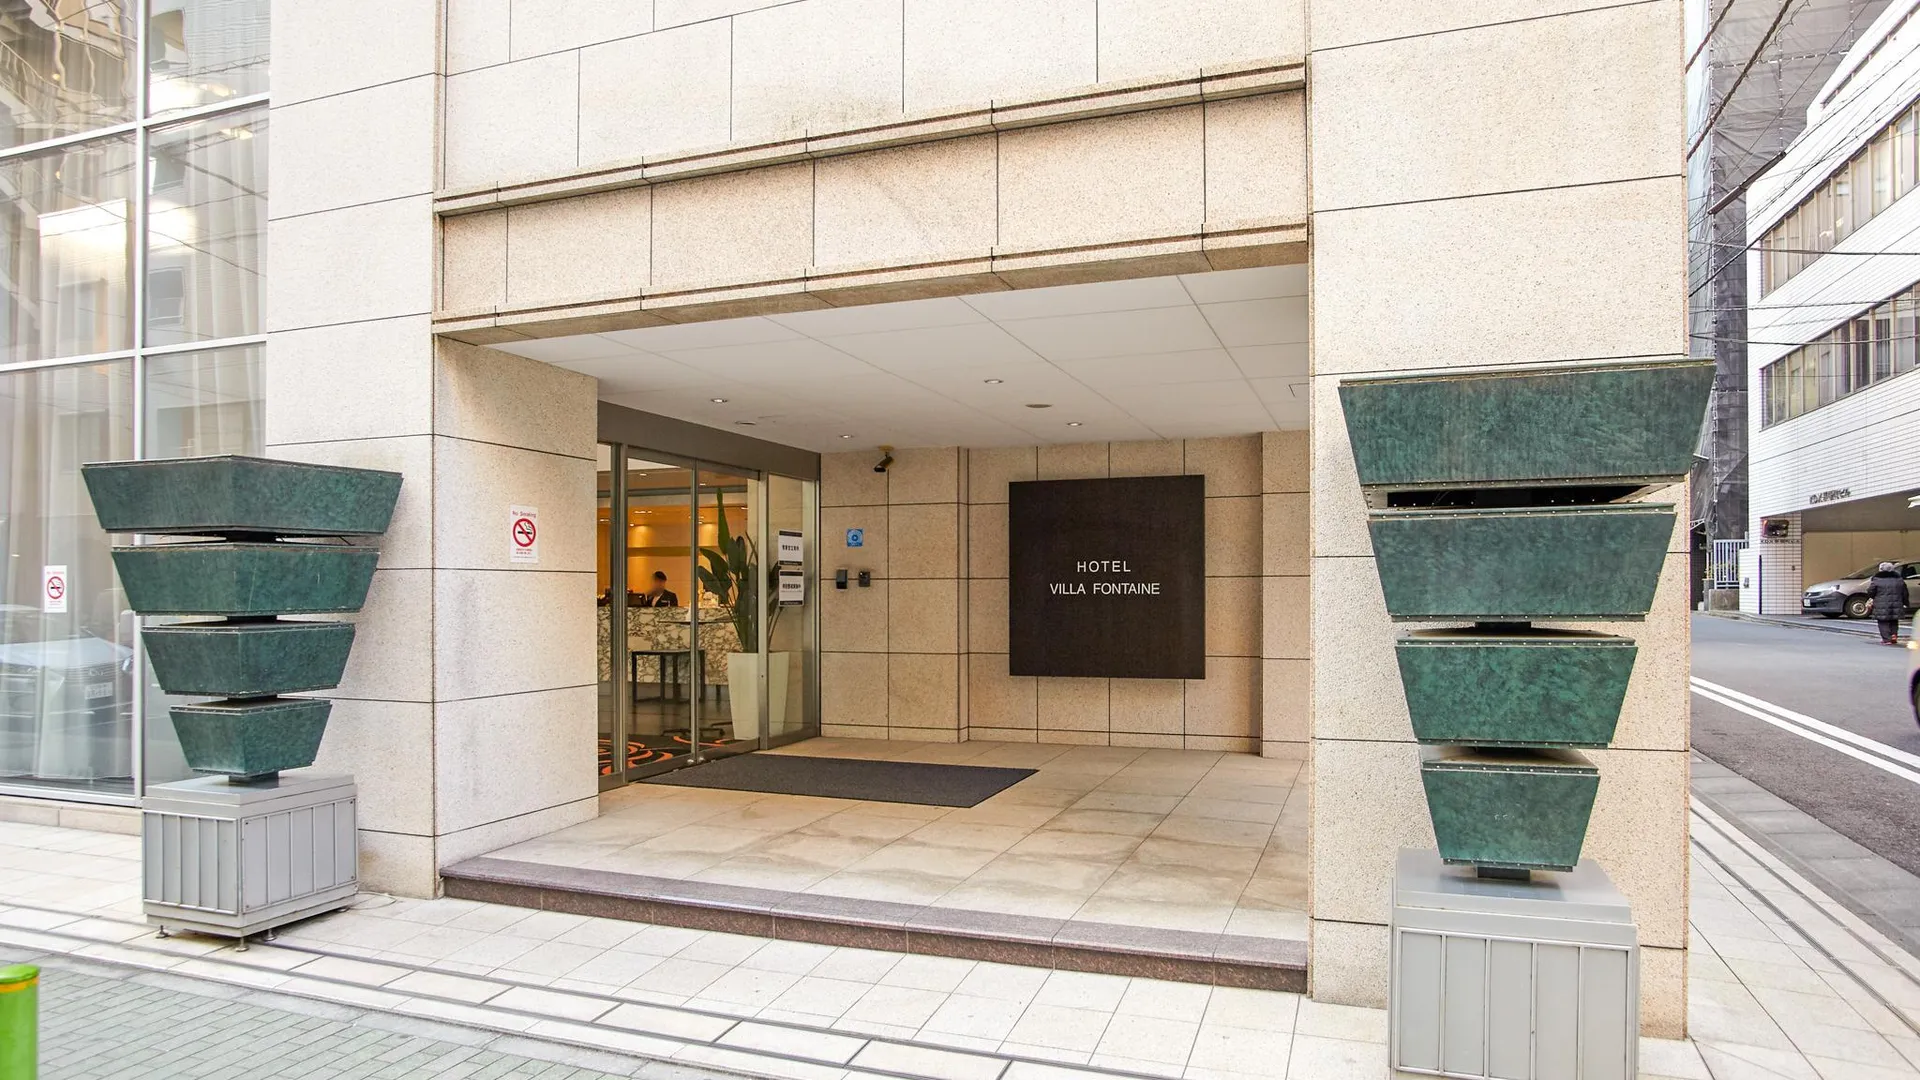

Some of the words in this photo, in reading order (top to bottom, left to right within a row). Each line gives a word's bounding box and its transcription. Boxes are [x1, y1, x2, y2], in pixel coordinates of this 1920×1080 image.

[1076, 560, 1131, 573] HOTEL
[1049, 583, 1086, 595] VILLA
[1093, 582, 1160, 595] FONTAINE
